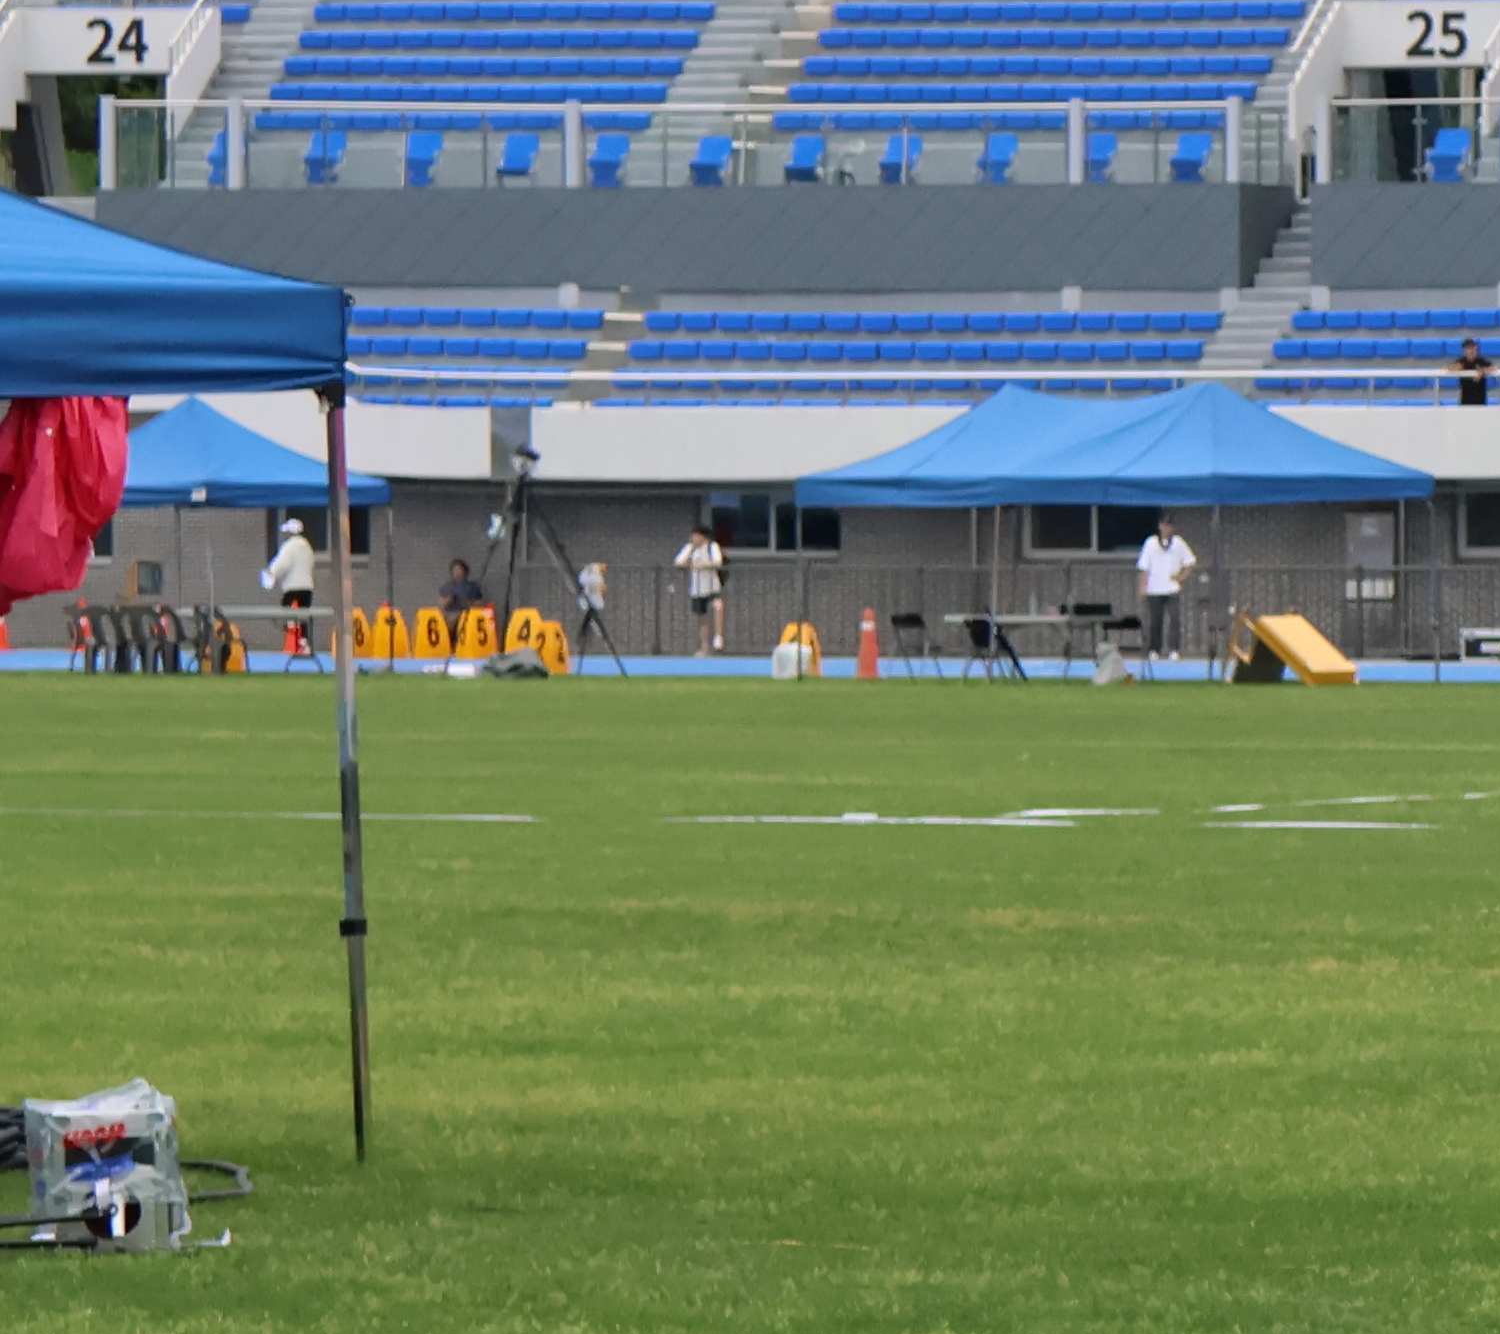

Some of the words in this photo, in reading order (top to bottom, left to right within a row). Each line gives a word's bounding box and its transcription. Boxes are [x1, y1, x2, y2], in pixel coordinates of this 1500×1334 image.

[86, 17, 148, 64] 24
[1406, 10, 1468, 58] 25
[427, 618, 440, 648] 6
[476, 617, 488, 646] 5
[517, 618, 531, 642] 4
